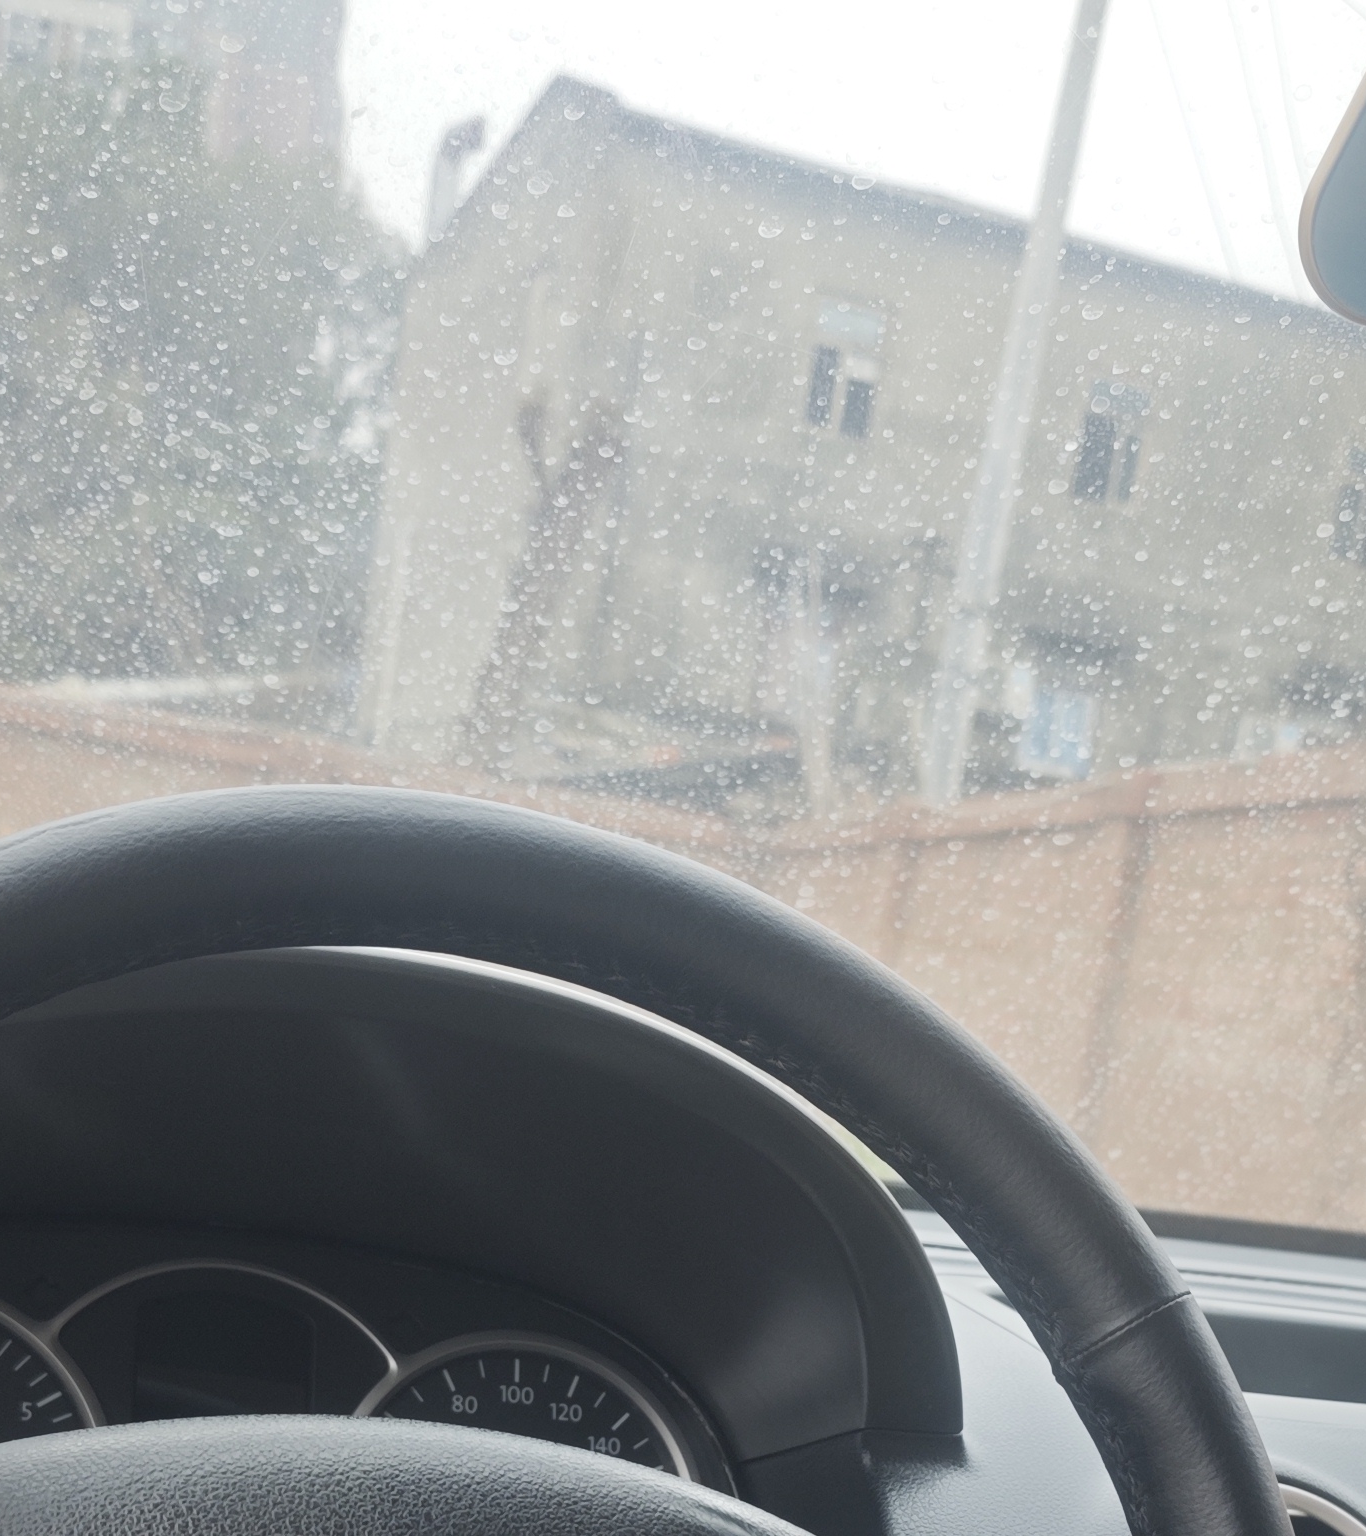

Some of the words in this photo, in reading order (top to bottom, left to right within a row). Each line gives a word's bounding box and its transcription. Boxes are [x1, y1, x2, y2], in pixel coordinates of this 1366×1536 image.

[452, 1395, 478, 1414] 80
[500, 1385, 535, 1405] 100
[21, 1402, 33, 1421] 5
[549, 1404, 583, 1423] 120
[587, 1435, 622, 1455] 140
